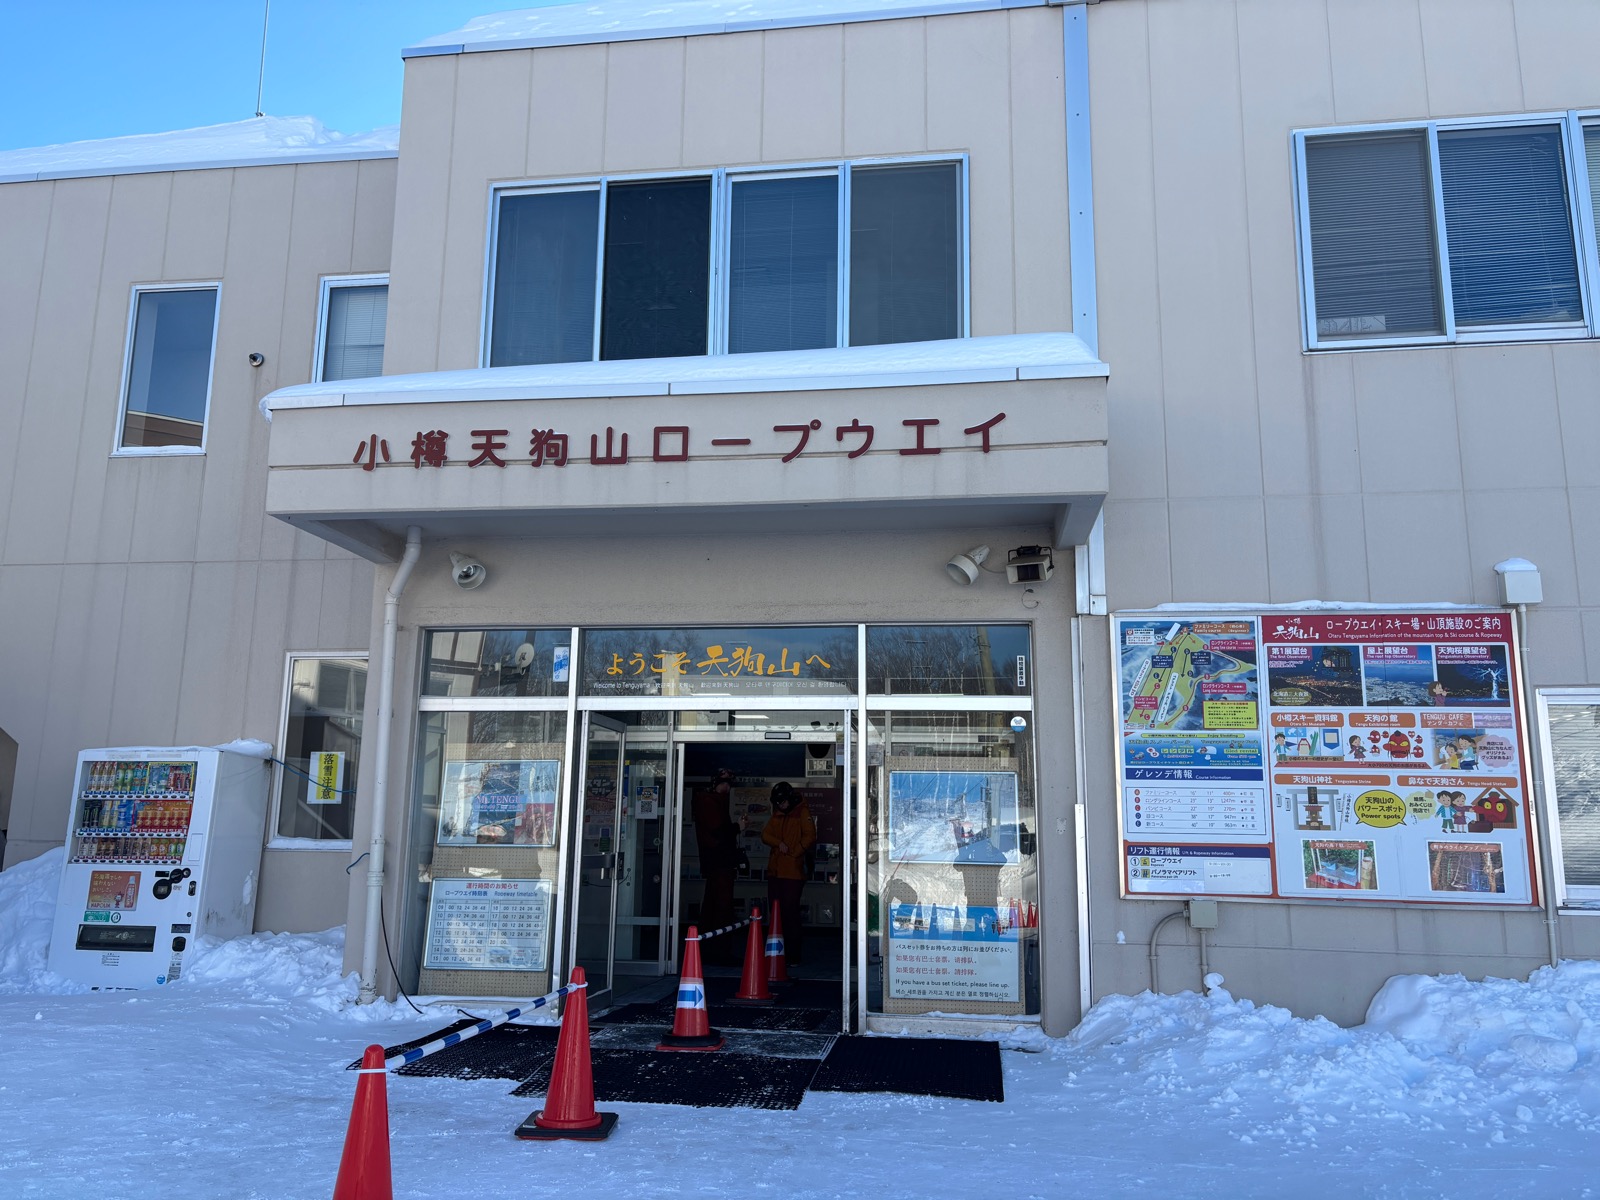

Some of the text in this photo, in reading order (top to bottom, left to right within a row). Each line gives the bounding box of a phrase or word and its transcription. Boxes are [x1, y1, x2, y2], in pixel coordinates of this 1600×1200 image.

[353, 412, 1007, 471] 小樽天狗山ロープウエイ
[606, 645, 831, 677] ようこそ天狗山へ
[1276, 714, 1338, 722] 小樽スキー資料館
[321, 754, 334, 799] 落雪注意
[1134, 770, 1193, 779] ゲレンデ情報
[1130, 846, 1180, 856] リフト運行情報
